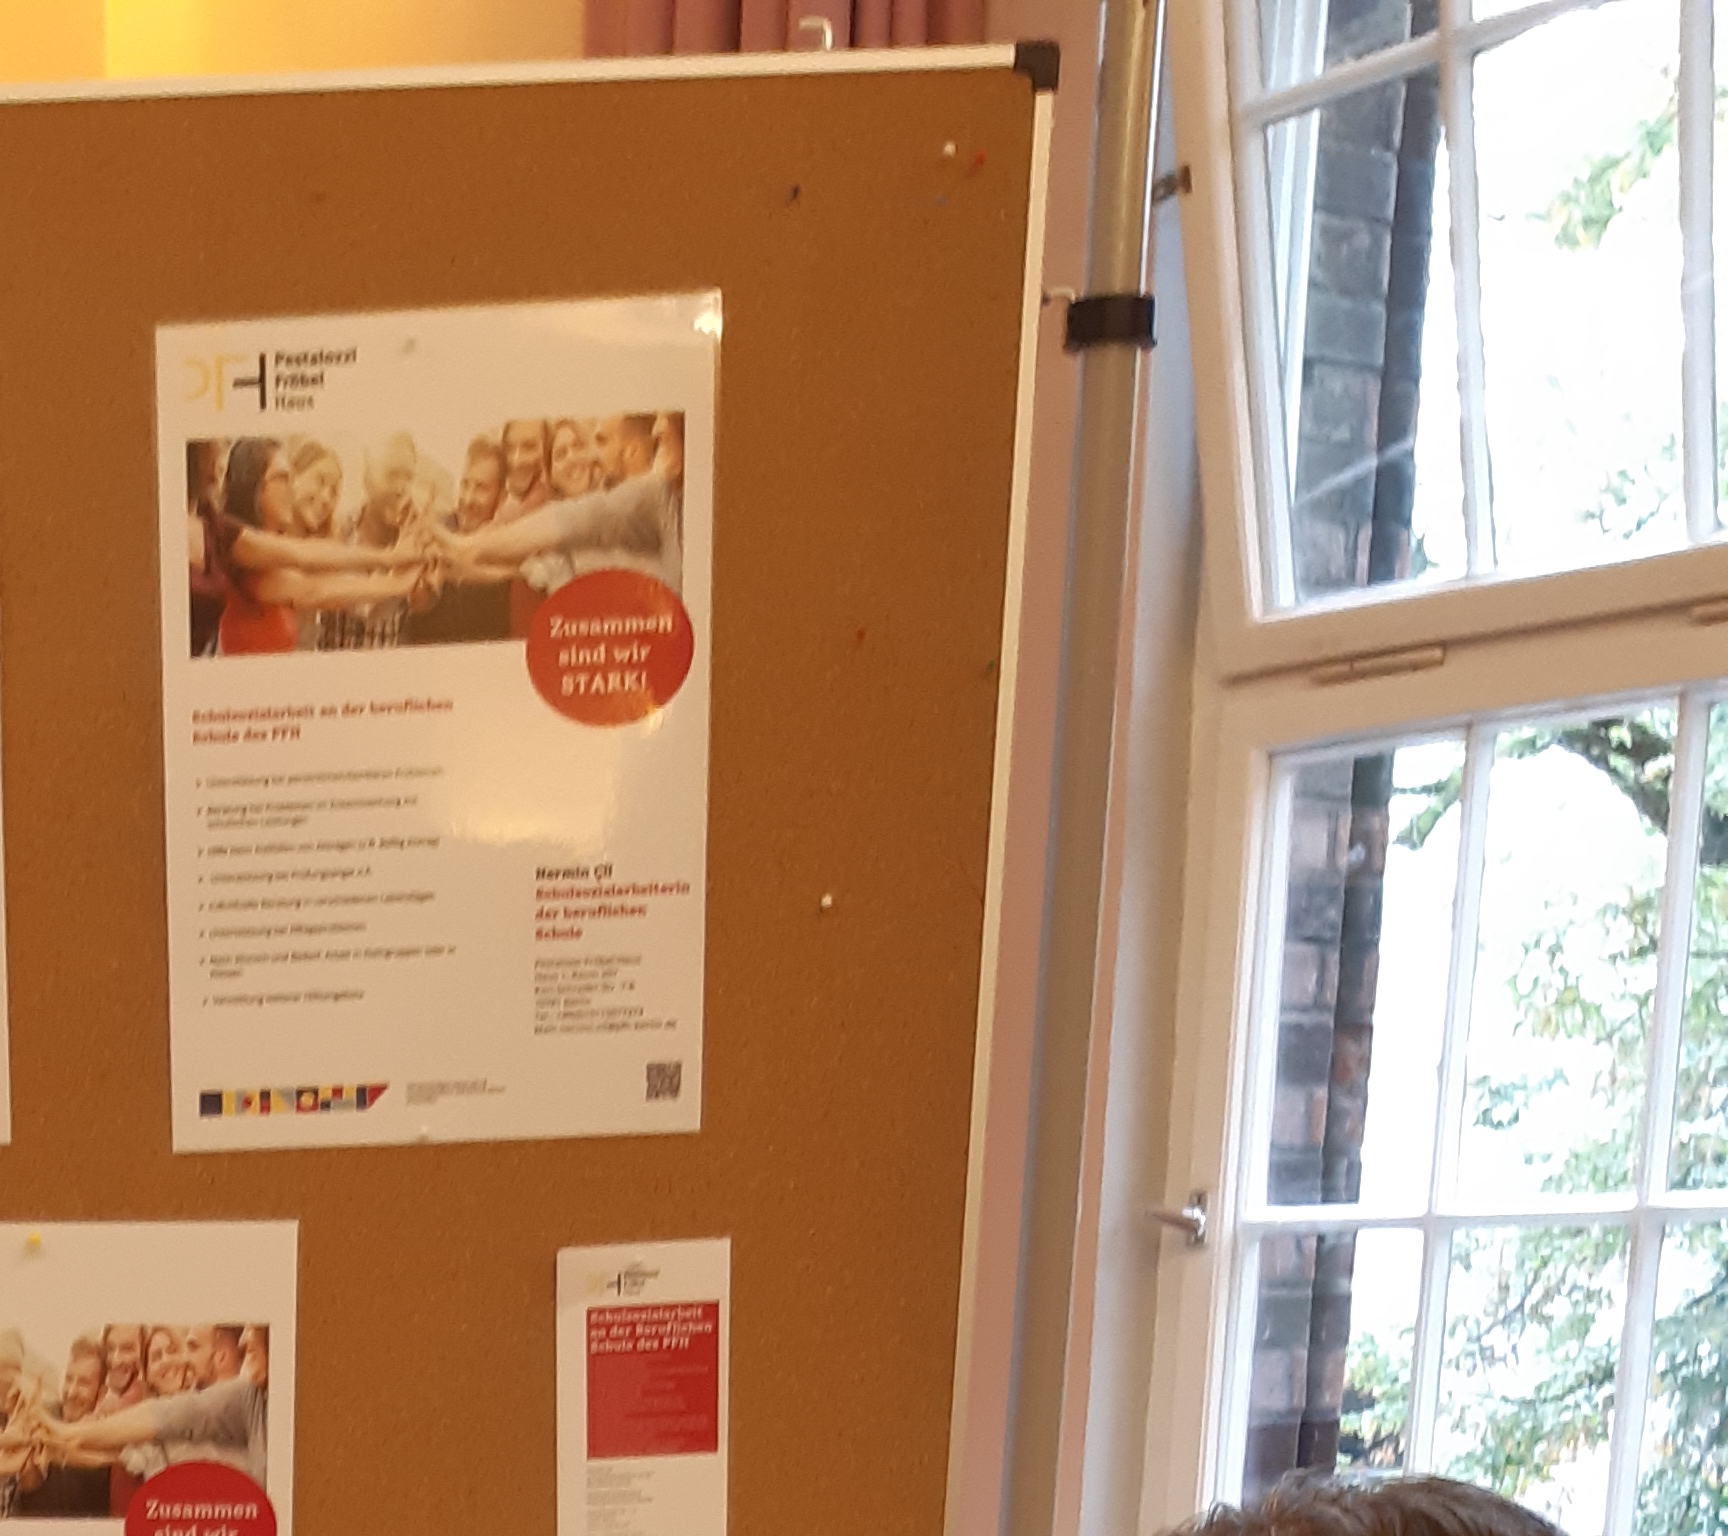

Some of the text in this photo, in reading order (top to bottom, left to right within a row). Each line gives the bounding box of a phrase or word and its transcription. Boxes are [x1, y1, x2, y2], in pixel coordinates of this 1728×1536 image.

[550, 614, 673, 639] Zusammen
[559, 639, 651, 667] sind wir
[561, 669, 647, 696] STARK!
[145, 1499, 257, 1520] Zusammen
